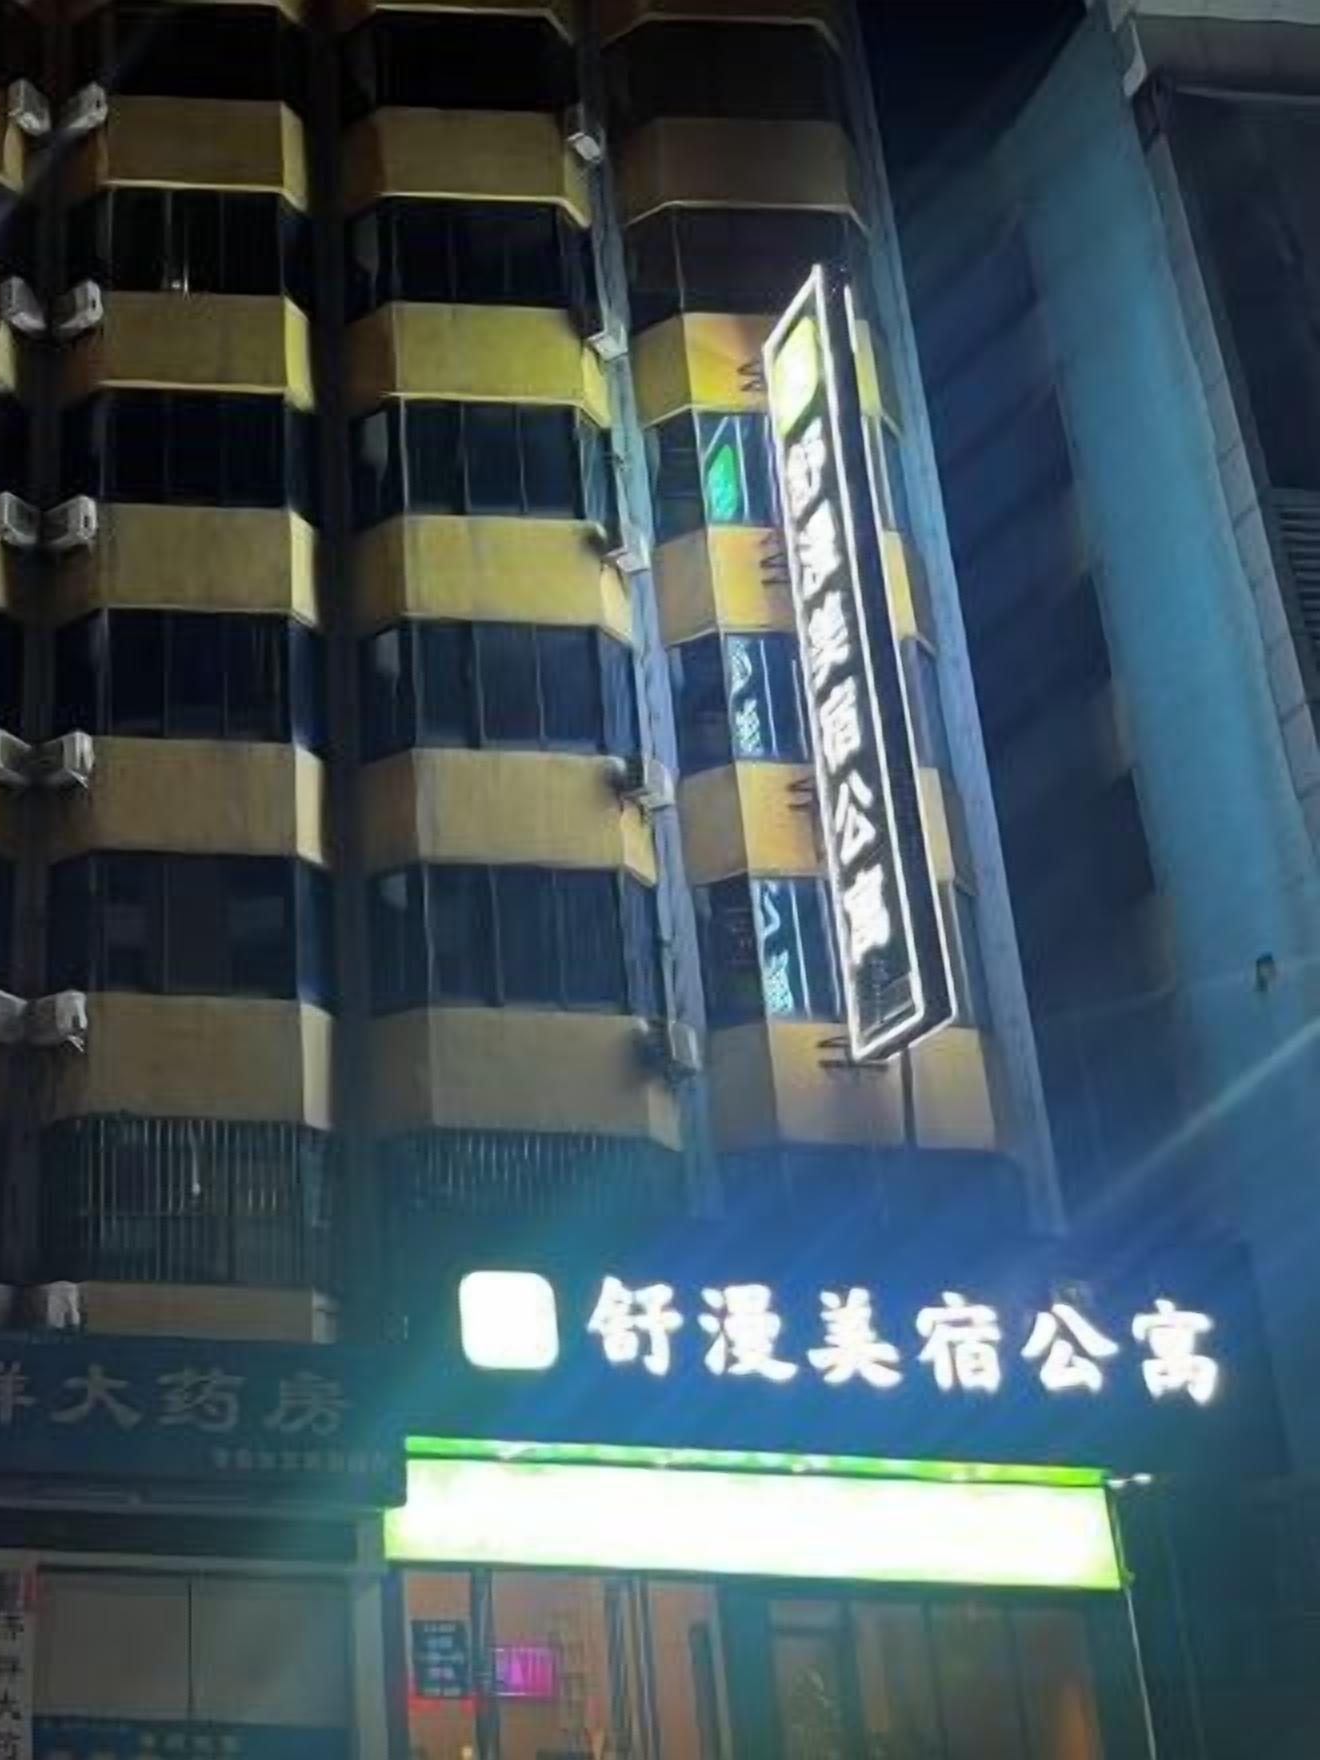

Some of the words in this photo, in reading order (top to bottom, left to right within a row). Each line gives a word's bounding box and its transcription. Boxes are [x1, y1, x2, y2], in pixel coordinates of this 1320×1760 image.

[587, 1275, 1220, 1404] 舒漫美宿公寓
